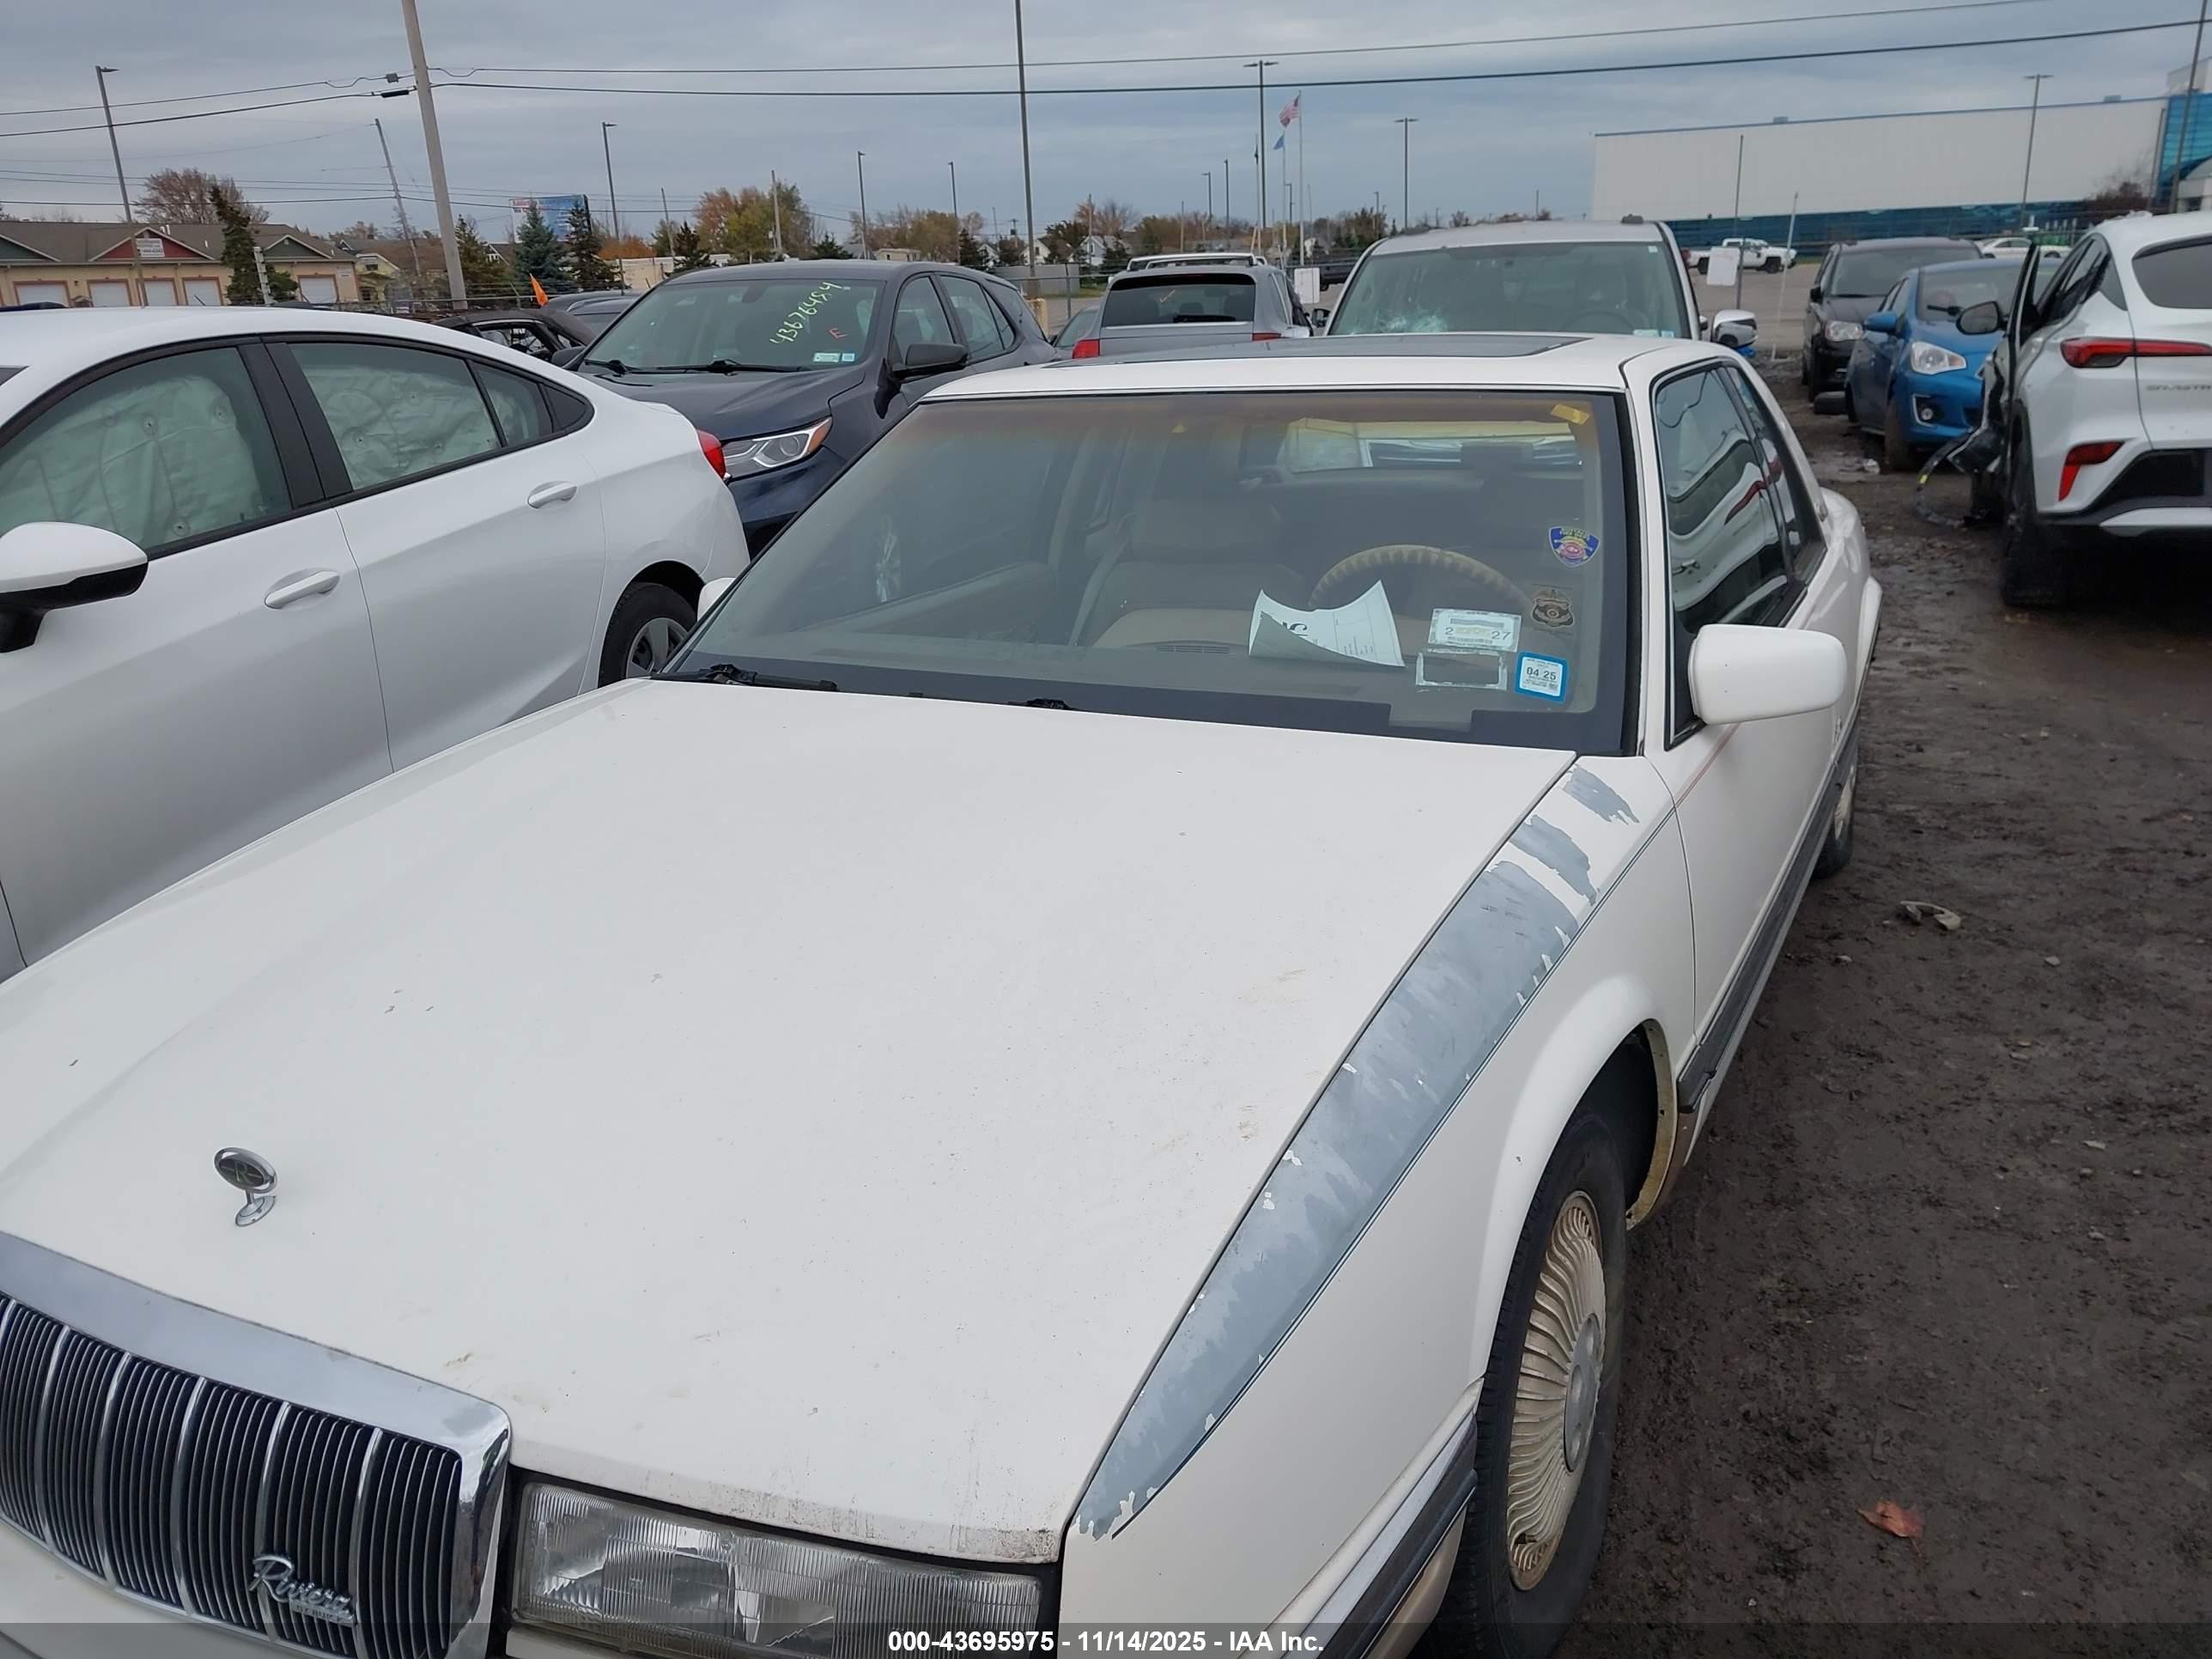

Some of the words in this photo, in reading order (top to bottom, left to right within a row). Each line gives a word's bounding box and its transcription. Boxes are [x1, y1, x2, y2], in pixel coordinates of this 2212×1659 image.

[769, 282, 842, 344] 43676454
[1444, 626, 1455, 636] 2
[1492, 630, 1512, 641] 27
[1526, 666, 1540, 677] 04
[1543, 670, 1557, 681] 25
